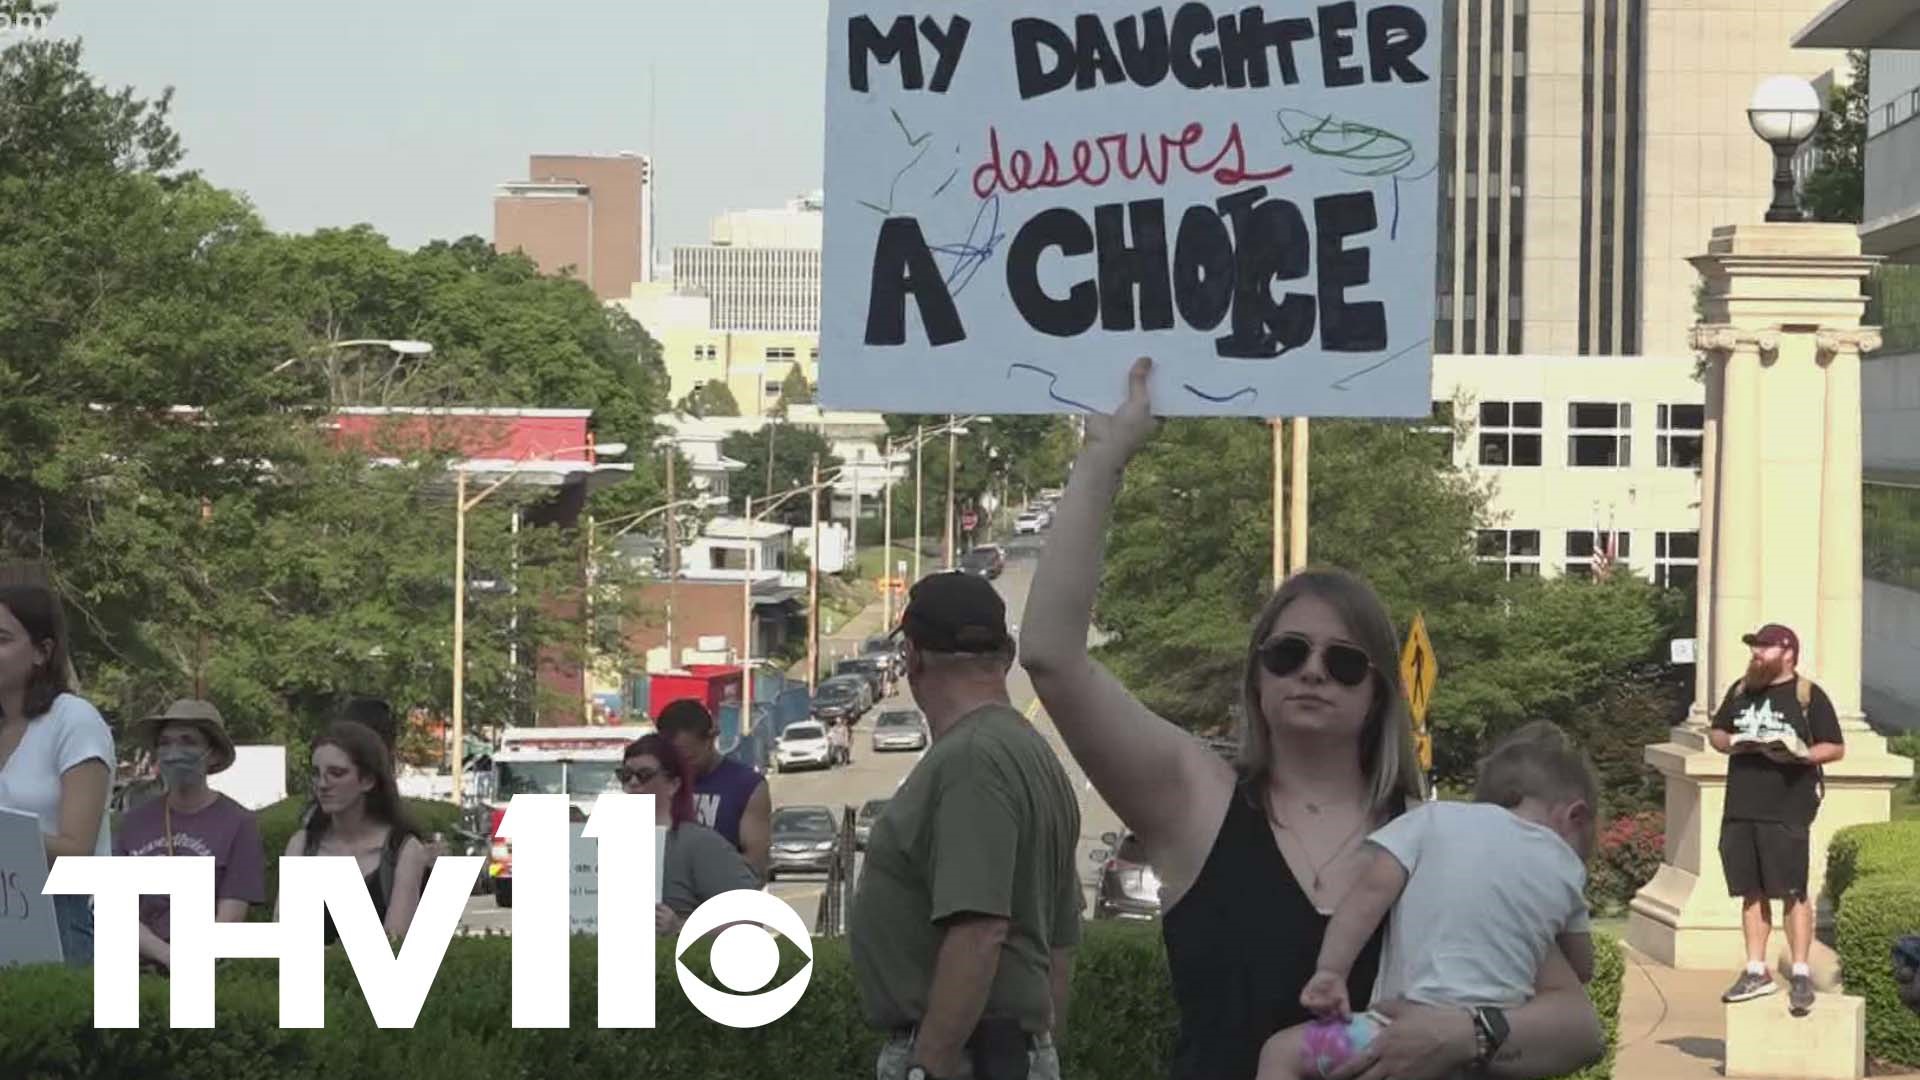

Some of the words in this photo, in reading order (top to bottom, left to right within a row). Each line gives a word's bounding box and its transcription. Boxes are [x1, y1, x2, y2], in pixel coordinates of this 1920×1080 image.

[848, 14, 971, 94] MY
[1011, 0, 1430, 99] DAUGHTER
[972, 121, 1293, 200] deserves
[864, 216, 967, 346] A
[1005, 186, 1388, 359] CHOICE
